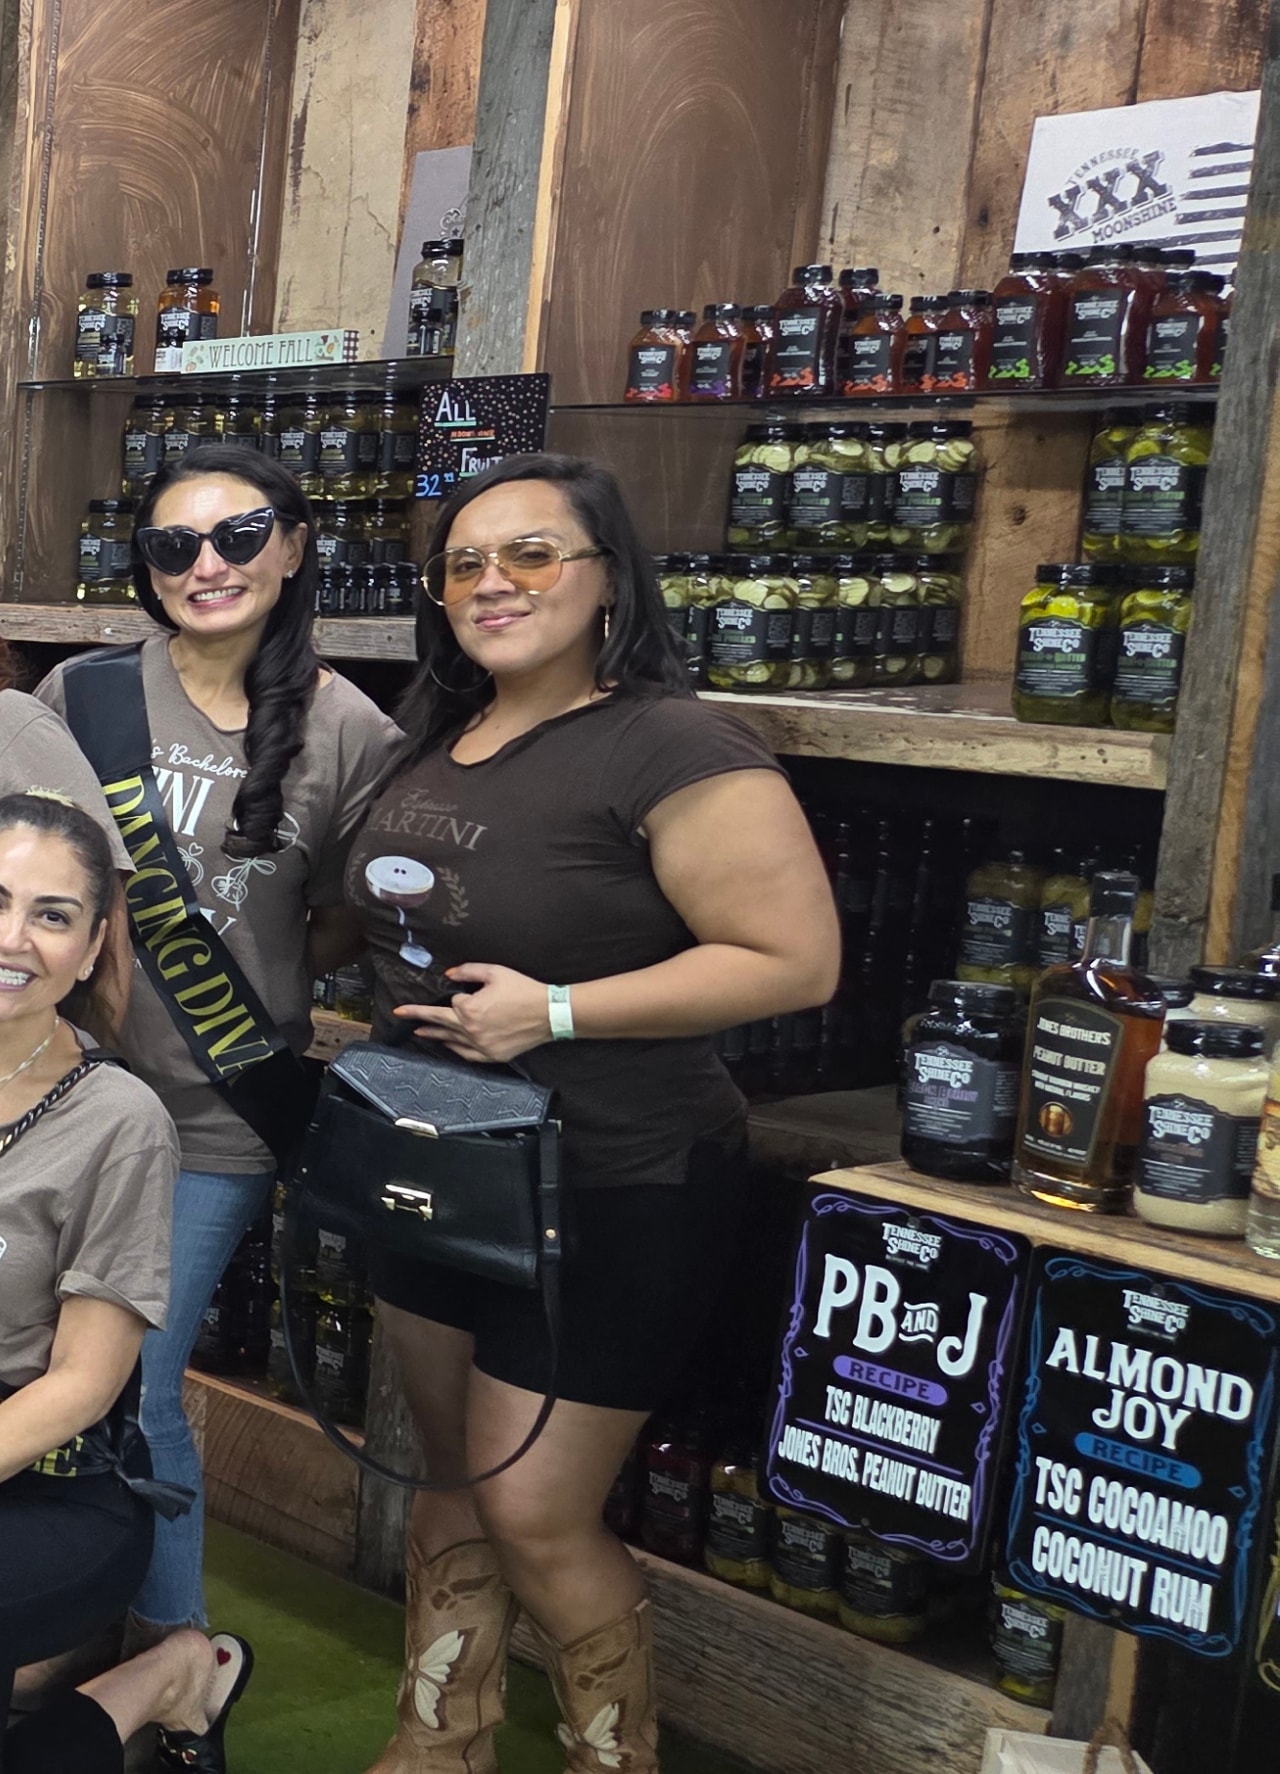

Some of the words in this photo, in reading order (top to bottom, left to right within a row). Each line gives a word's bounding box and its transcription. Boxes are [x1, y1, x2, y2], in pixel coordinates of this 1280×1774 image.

[1067, 147, 1140, 185] TENNESSEE
[1048, 150, 1175, 240] XXX
[1090, 199, 1177, 243] MOONSHINE
[208, 335, 276, 368] WELCOME
[278, 338, 313, 365] FALL
[435, 391, 477, 421] ALL
[416, 474, 442, 496] 32
[102, 776, 212, 981] DANCING
[914, 1053, 974, 1073] TENNESSEE
[882, 1222, 941, 1248] TENNESSEE
[813, 1253, 900, 1353] PB
[900, 1309, 938, 1334] AND
[936, 1292, 988, 1377] J
[1122, 1289, 1190, 1317] TENNESSEE
[849, 1361, 931, 1400] RECIPE
[1045, 1326, 1254, 1421] ALMOND
[825, 1385, 851, 1425] TSC
[851, 1393, 941, 1454] BLACKBERRY
[1091, 1388, 1192, 1450] JOY
[778, 1424, 822, 1469] JONES
[821, 1437, 859, 1484] BROS.
[861, 1452, 917, 1502] PEANUT
[914, 1469, 972, 1522] BUTTER
[1092, 1438, 1183, 1481] RECIPE
[1035, 1455, 1083, 1516] TSC
[1087, 1475, 1229, 1565] COCOAMOO
[1031, 1525, 1148, 1609] COCONUT
[1149, 1566, 1213, 1634] RUM
